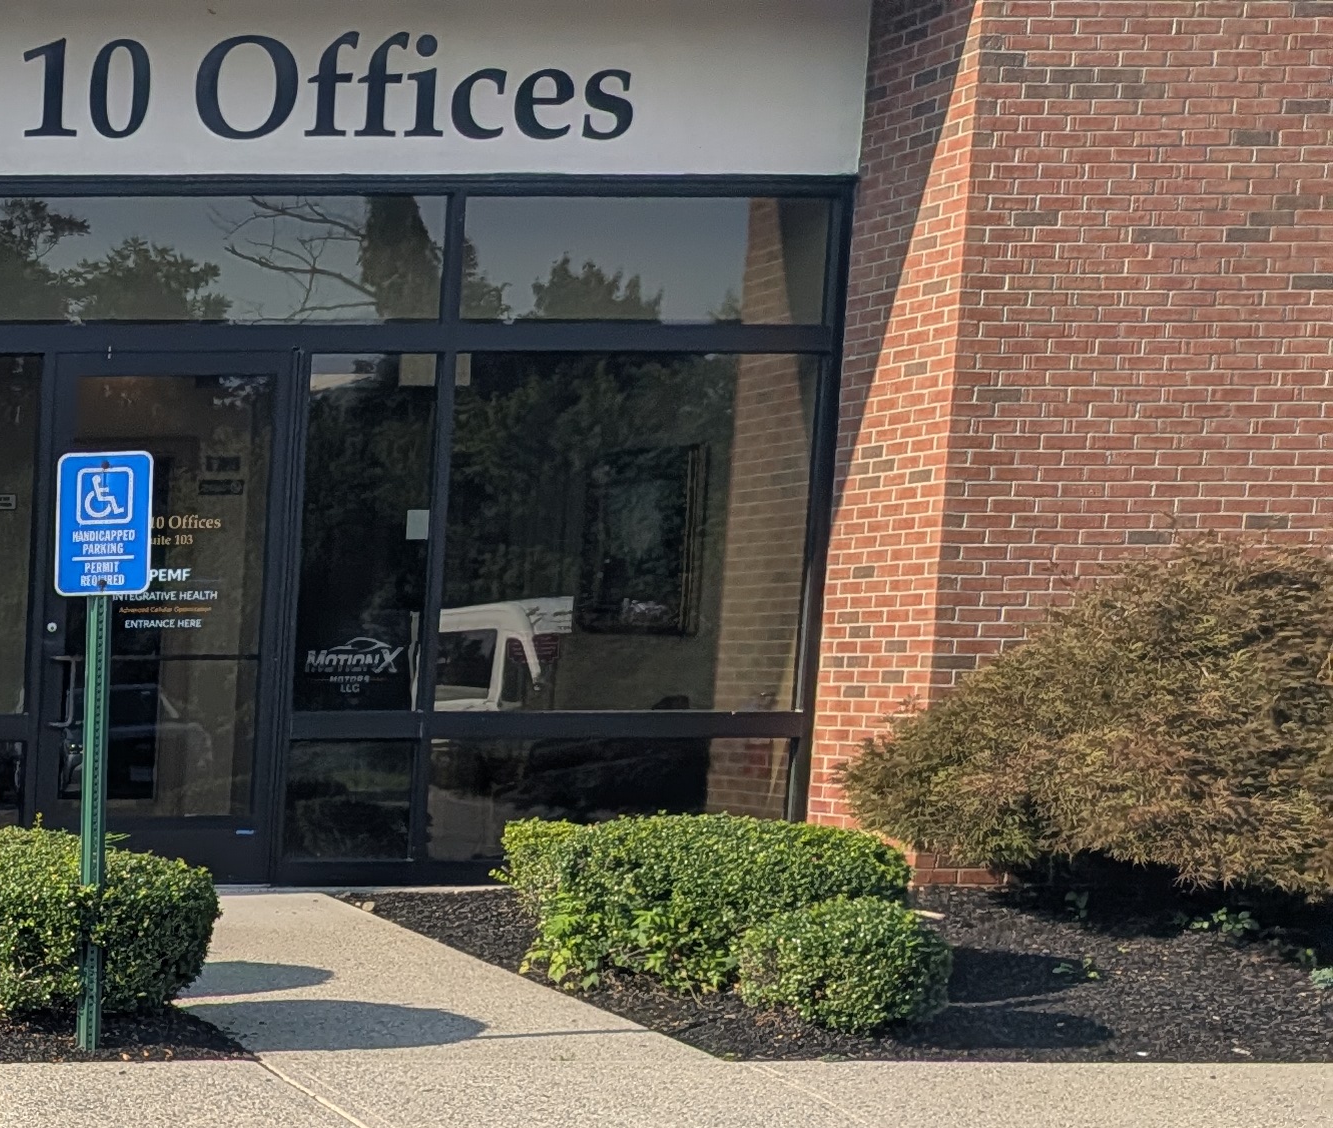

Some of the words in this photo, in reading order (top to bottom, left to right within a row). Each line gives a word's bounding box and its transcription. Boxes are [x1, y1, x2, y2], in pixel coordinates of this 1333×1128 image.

[23, 37, 151, 139] 10
[195, 31, 634, 141] Offices
[168, 514, 222, 530] Offices
[72, 529, 136, 543] HANDICAPPED
[150, 535, 172, 546] uite
[174, 534, 194, 545] 103
[82, 543, 124, 555] PARKING
[84, 561, 119, 573] PERMIT
[149, 568, 192, 582] PEMF
[113, 591, 177, 601] INTEGRATIVE
[179, 590, 218, 600] HEALTH
[124, 619, 176, 629] ENTRANCE
[177, 619, 202, 628] HERE
